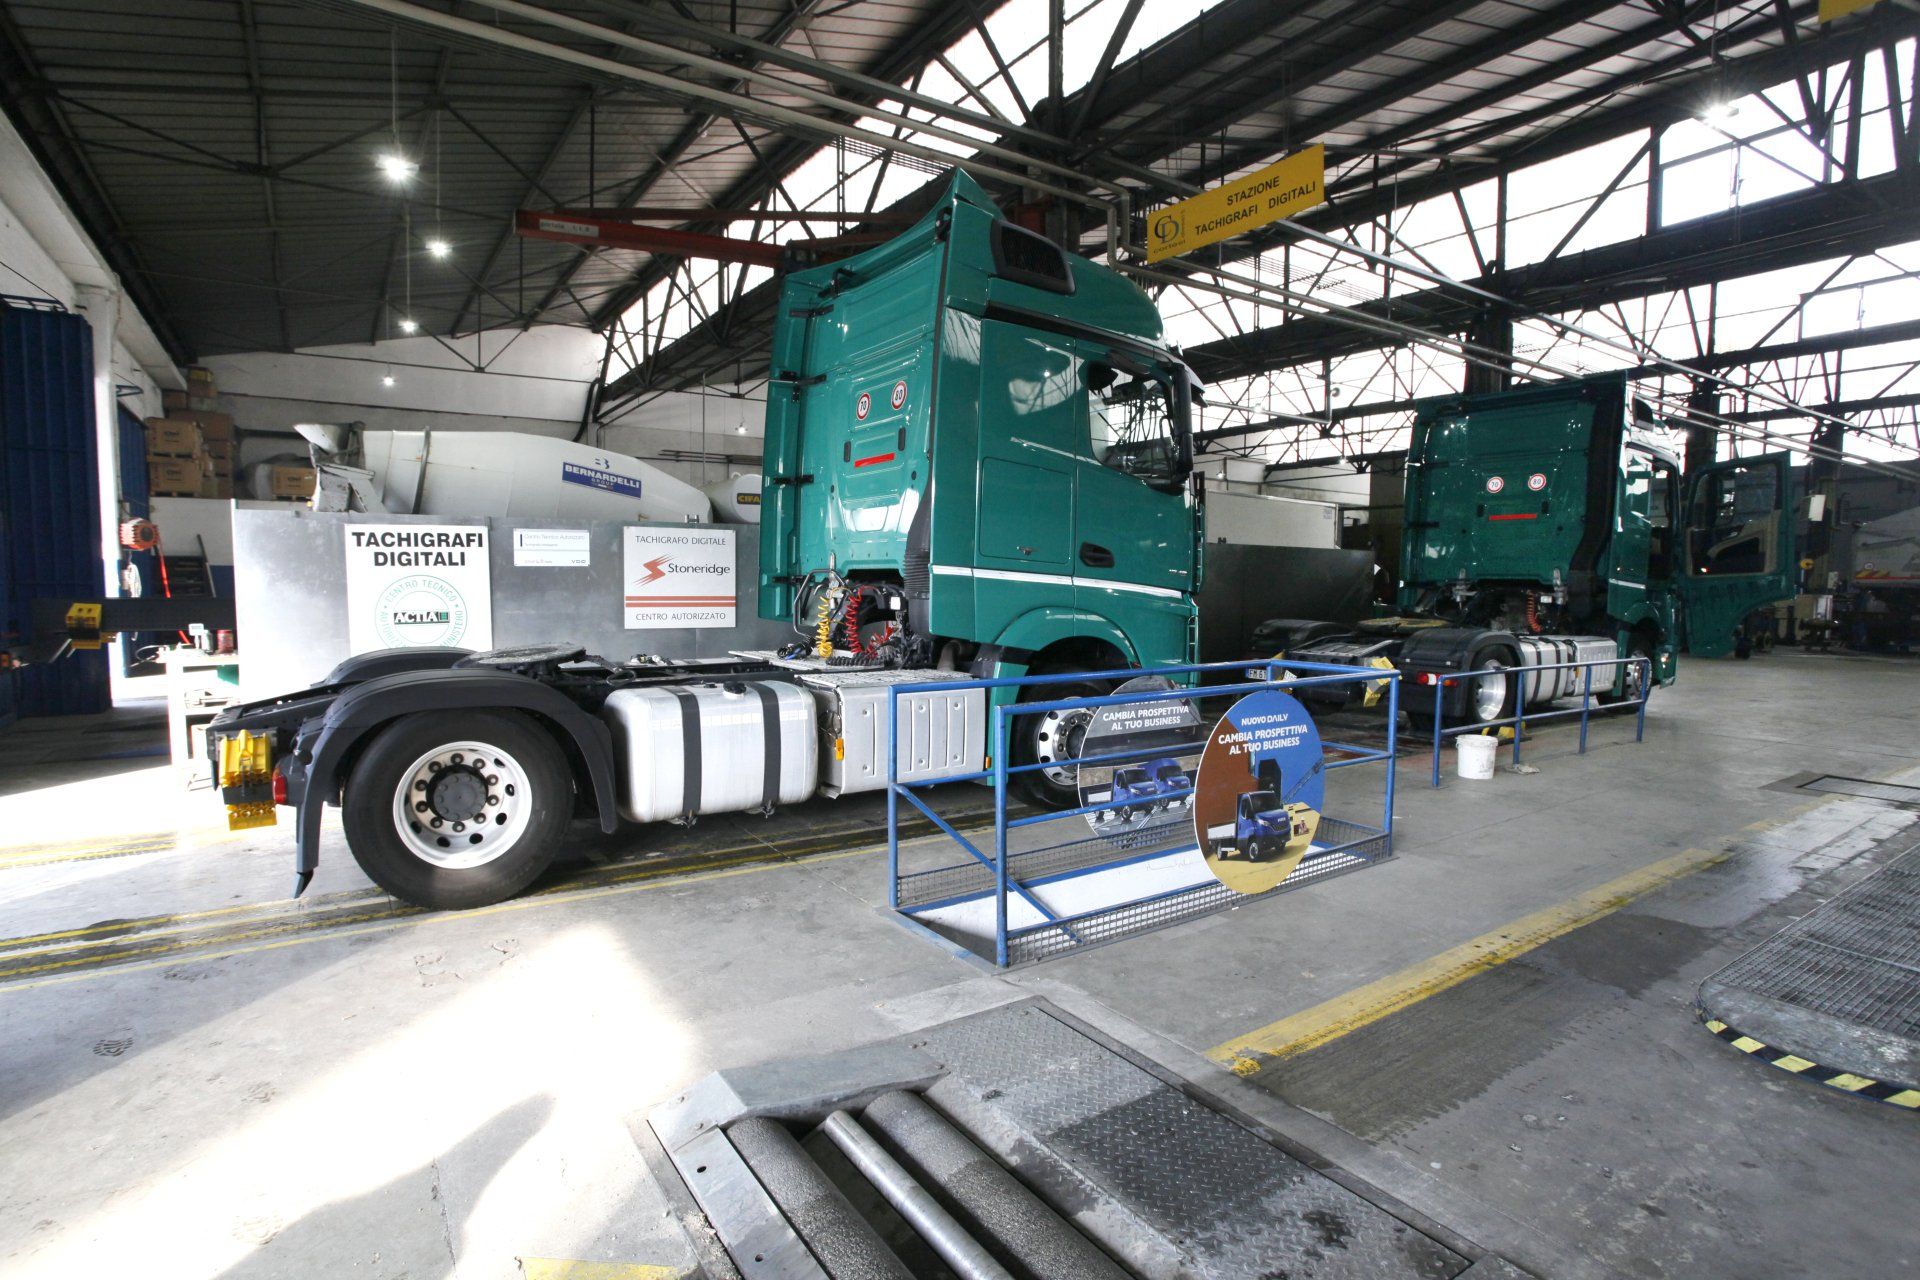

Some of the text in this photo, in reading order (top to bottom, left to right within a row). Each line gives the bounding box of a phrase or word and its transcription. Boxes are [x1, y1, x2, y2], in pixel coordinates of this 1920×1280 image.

[1227, 176, 1280, 206] STAZIONE
[1195, 204, 1258, 235] TACHIGRAFI
[1268, 181, 1316, 209] DIGITALI
[894, 389, 903, 401] 80
[860, 400, 867, 411] 70
[565, 464, 640, 488] BERNARDELLI
[738, 495, 760, 503] CIFA
[351, 532, 483, 547] TACHIGRAFI
[635, 536, 726, 545] TACHIGRAFO DIGITALE
[374, 551, 466, 566] DIGITALI
[668, 563, 731, 576] Stoneridge
[385, 579, 458, 603] CENTRO TECNICO
[394, 611, 438, 623] ACTIA
[636, 612, 726, 621] CENTRO AUTORIZZATO
[1103, 705, 1189, 721] CAMBIA PROSPETTIVA
[1111, 716, 1181, 731] AL TUO BUSINESS
[1241, 716, 1267, 726] NUOVO
[1218, 724, 1308, 744] CAMBIA PROSPETTIVA
[1229, 736, 1300, 755] AL TUO BUSINESS
